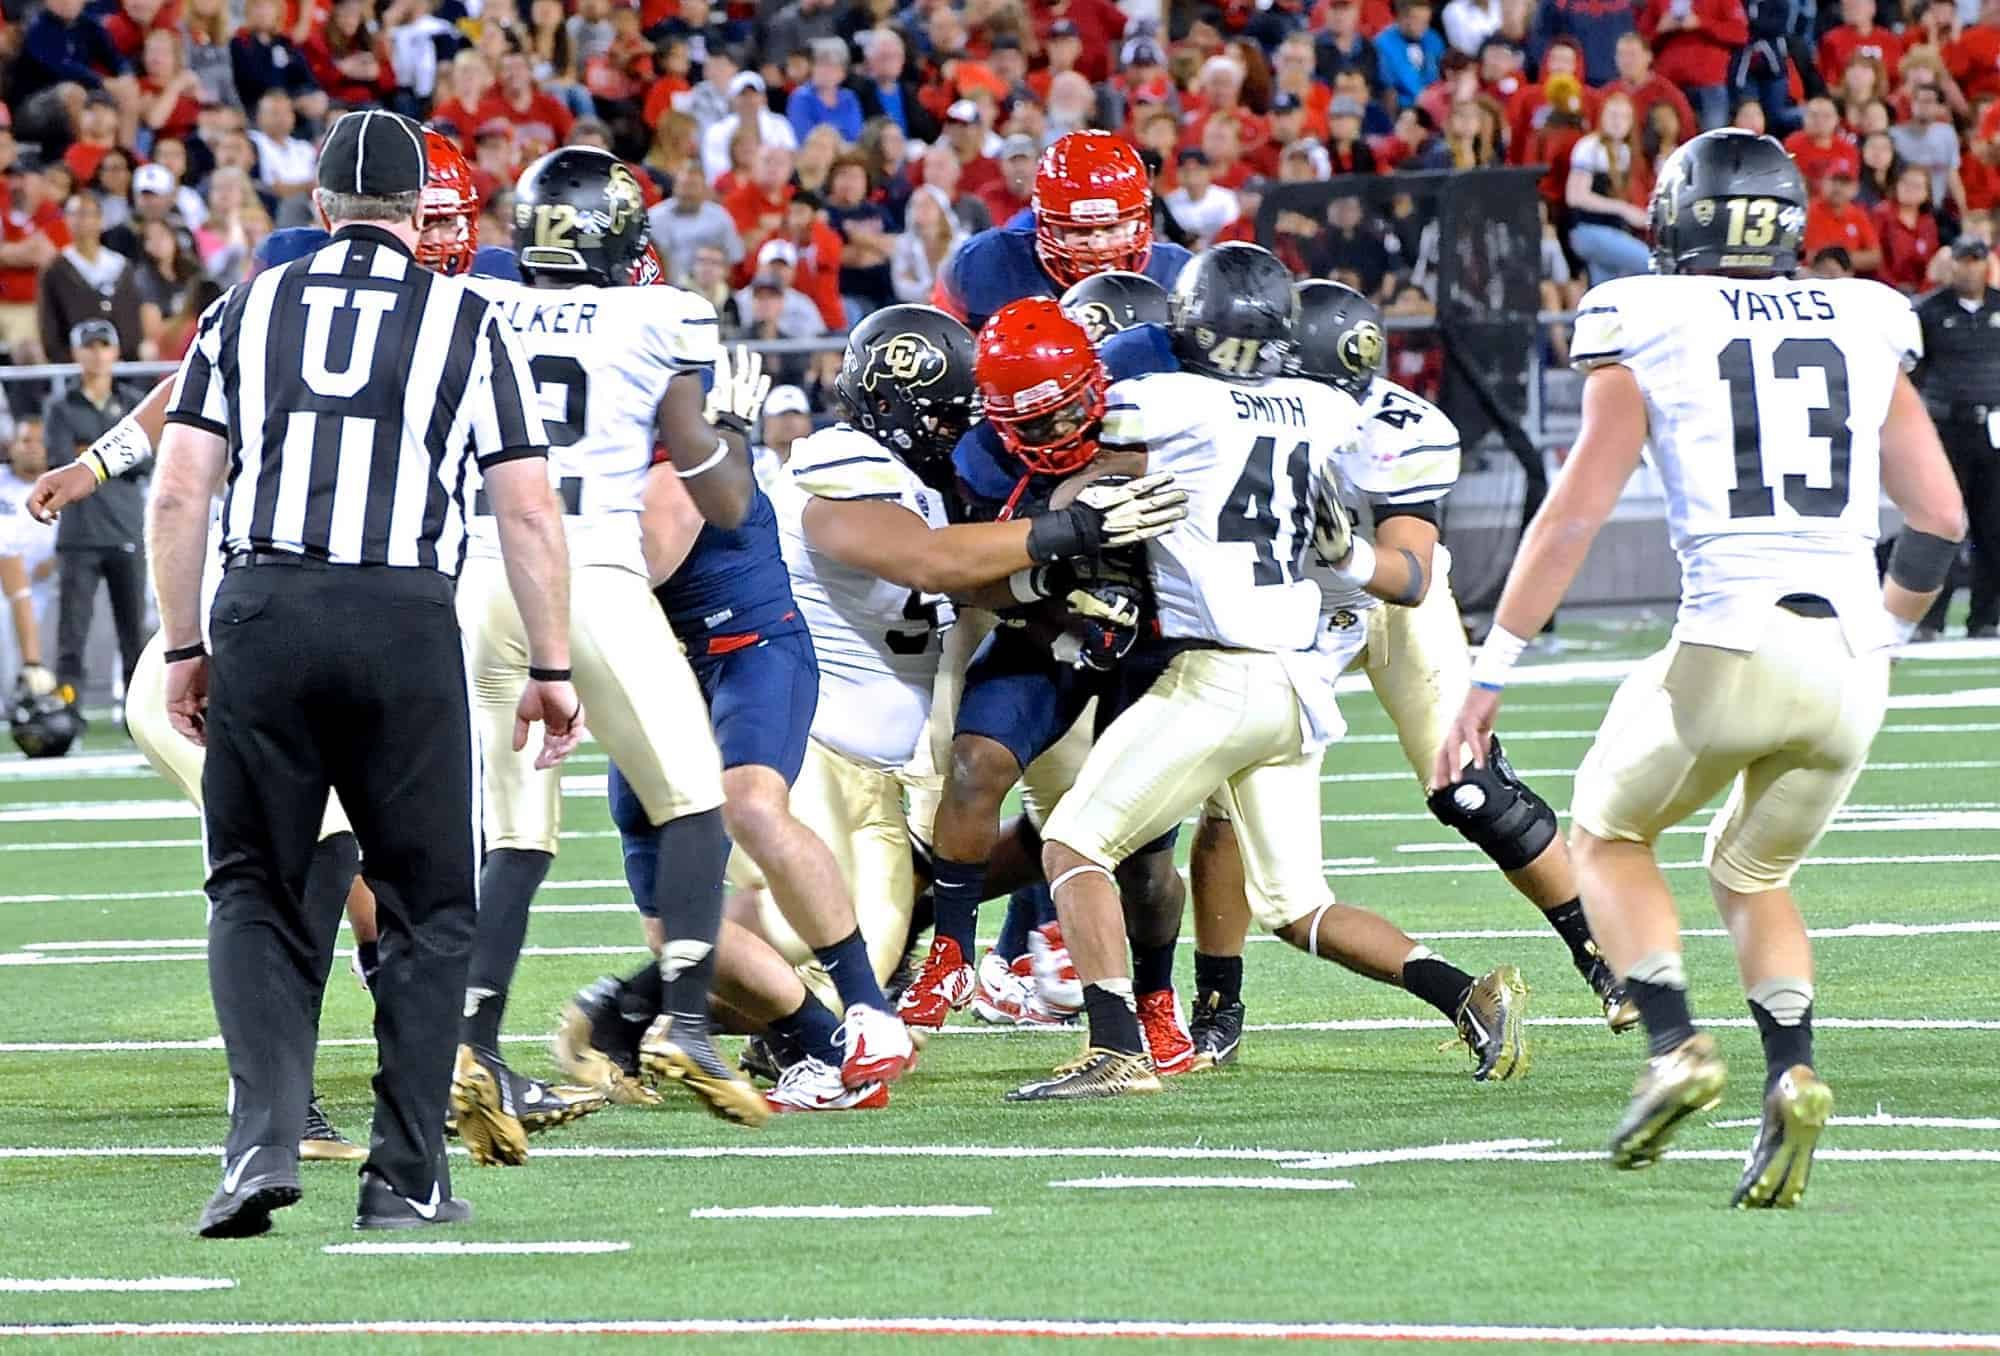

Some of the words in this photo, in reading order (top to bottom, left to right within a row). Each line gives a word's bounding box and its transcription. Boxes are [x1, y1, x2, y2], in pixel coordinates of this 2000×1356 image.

[534, 204, 577, 249] 12
[1725, 198, 1781, 247] 13
[1719, 288, 1836, 321] YATES
[301, 286, 399, 398] U
[1208, 337, 1262, 374] 41
[1230, 389, 1307, 428] SMITH
[1717, 337, 1853, 519] 13
[1216, 436, 1311, 588] 41
